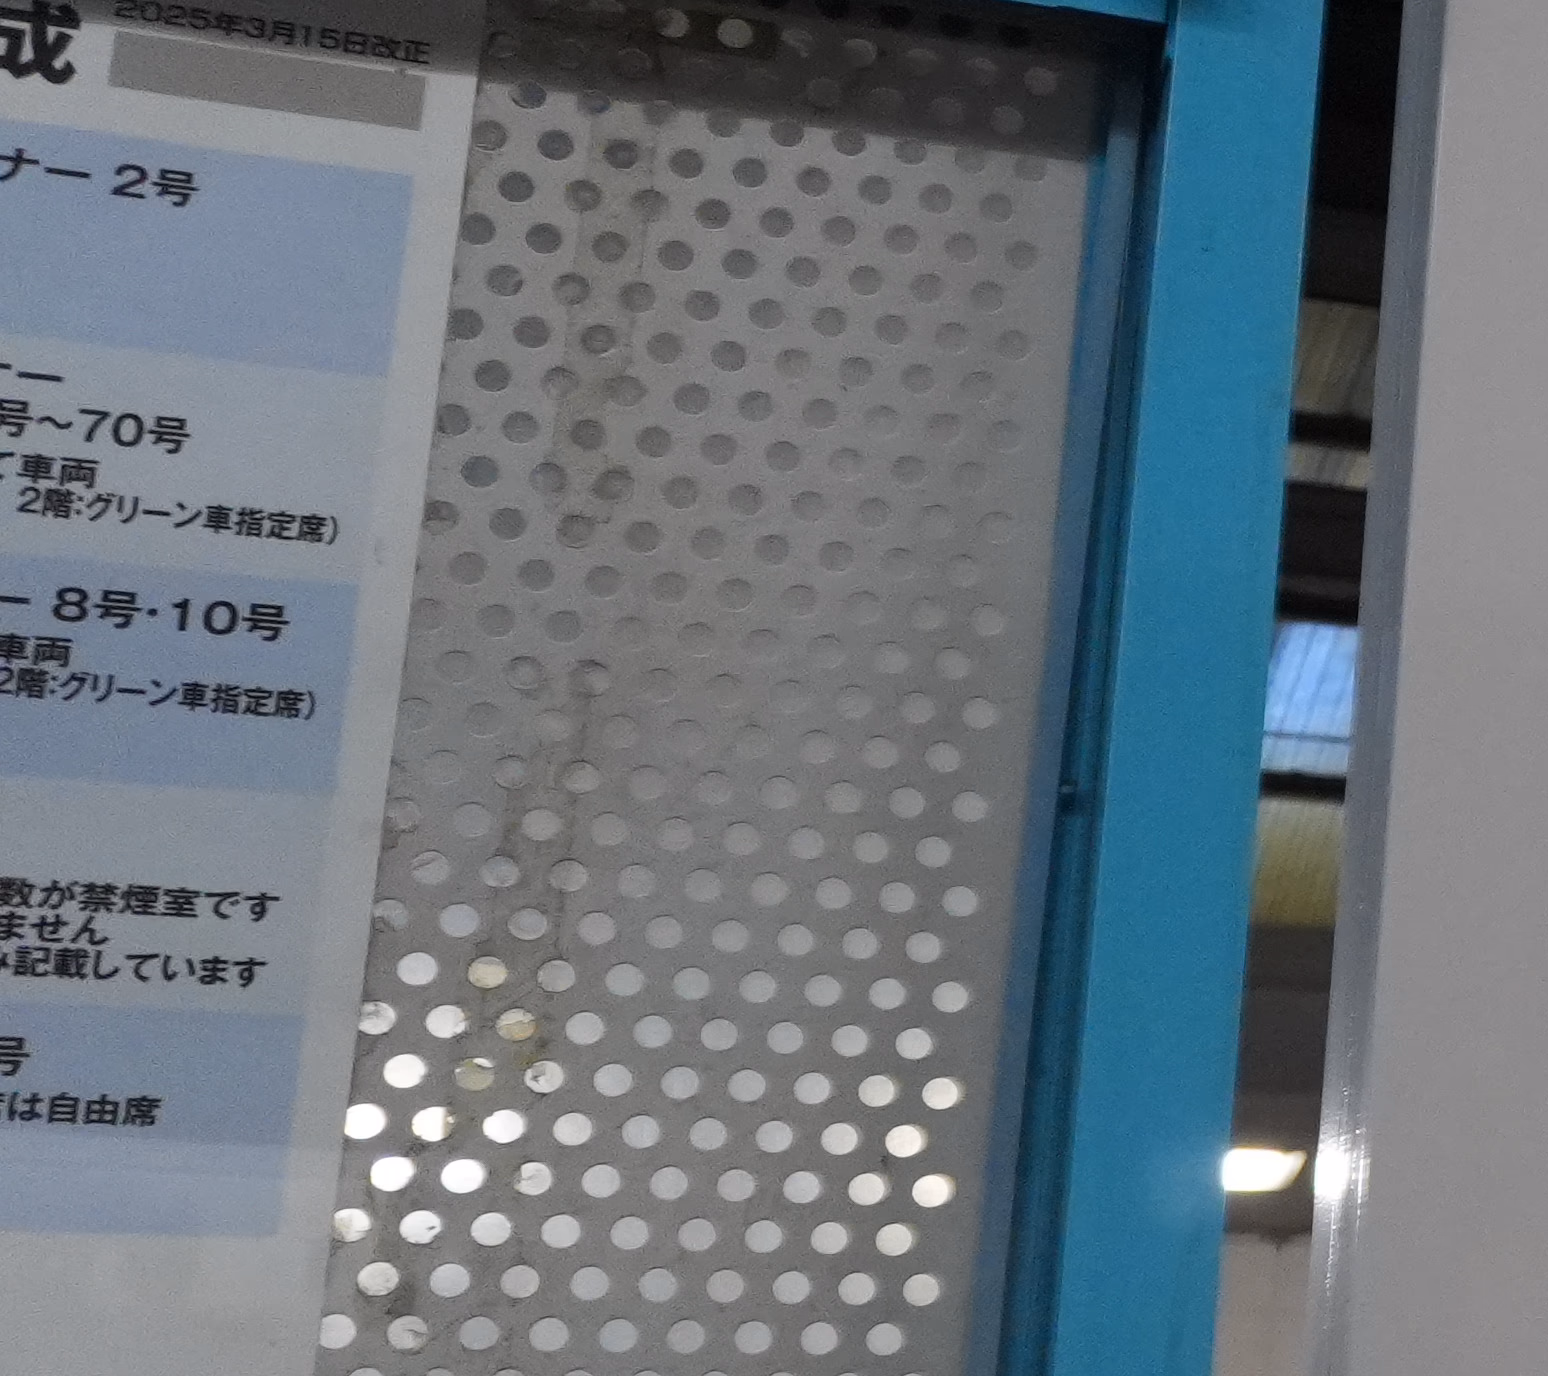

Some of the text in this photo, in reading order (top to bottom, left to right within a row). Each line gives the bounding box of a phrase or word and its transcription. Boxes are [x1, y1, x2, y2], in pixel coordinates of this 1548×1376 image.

[0, 946, 268, 988] 記載しています
[0, 1091, 164, 1126] は自由席
